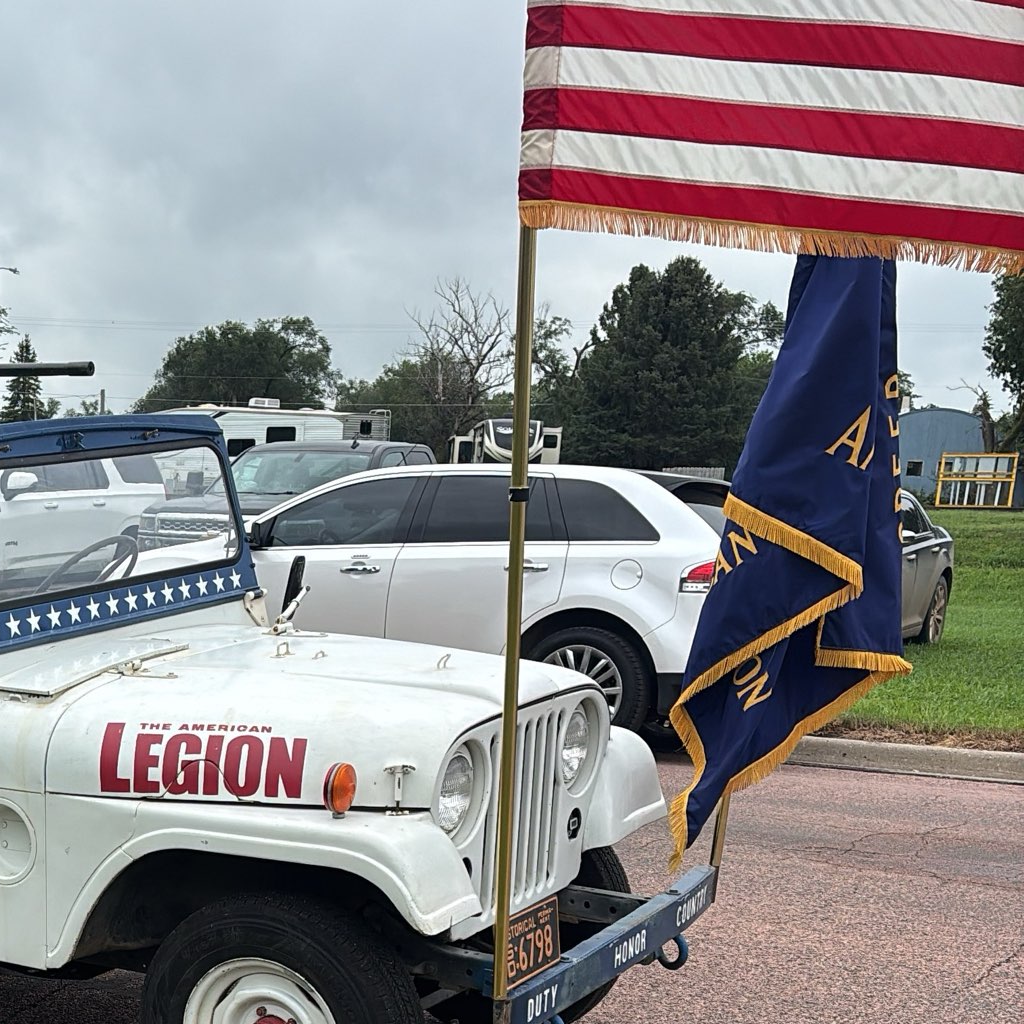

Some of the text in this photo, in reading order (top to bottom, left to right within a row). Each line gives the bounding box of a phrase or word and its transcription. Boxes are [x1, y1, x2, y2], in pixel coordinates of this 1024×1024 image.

[825, 404, 875, 471] A
[709, 528, 759, 588] AN
[139, 722, 273, 734] THE AMERICAN
[99, 722, 308, 799] LEGION
[519, 924, 553, 971] 6798
[527, 885, 708, 1023] DUTY HONOR COUNTRY
